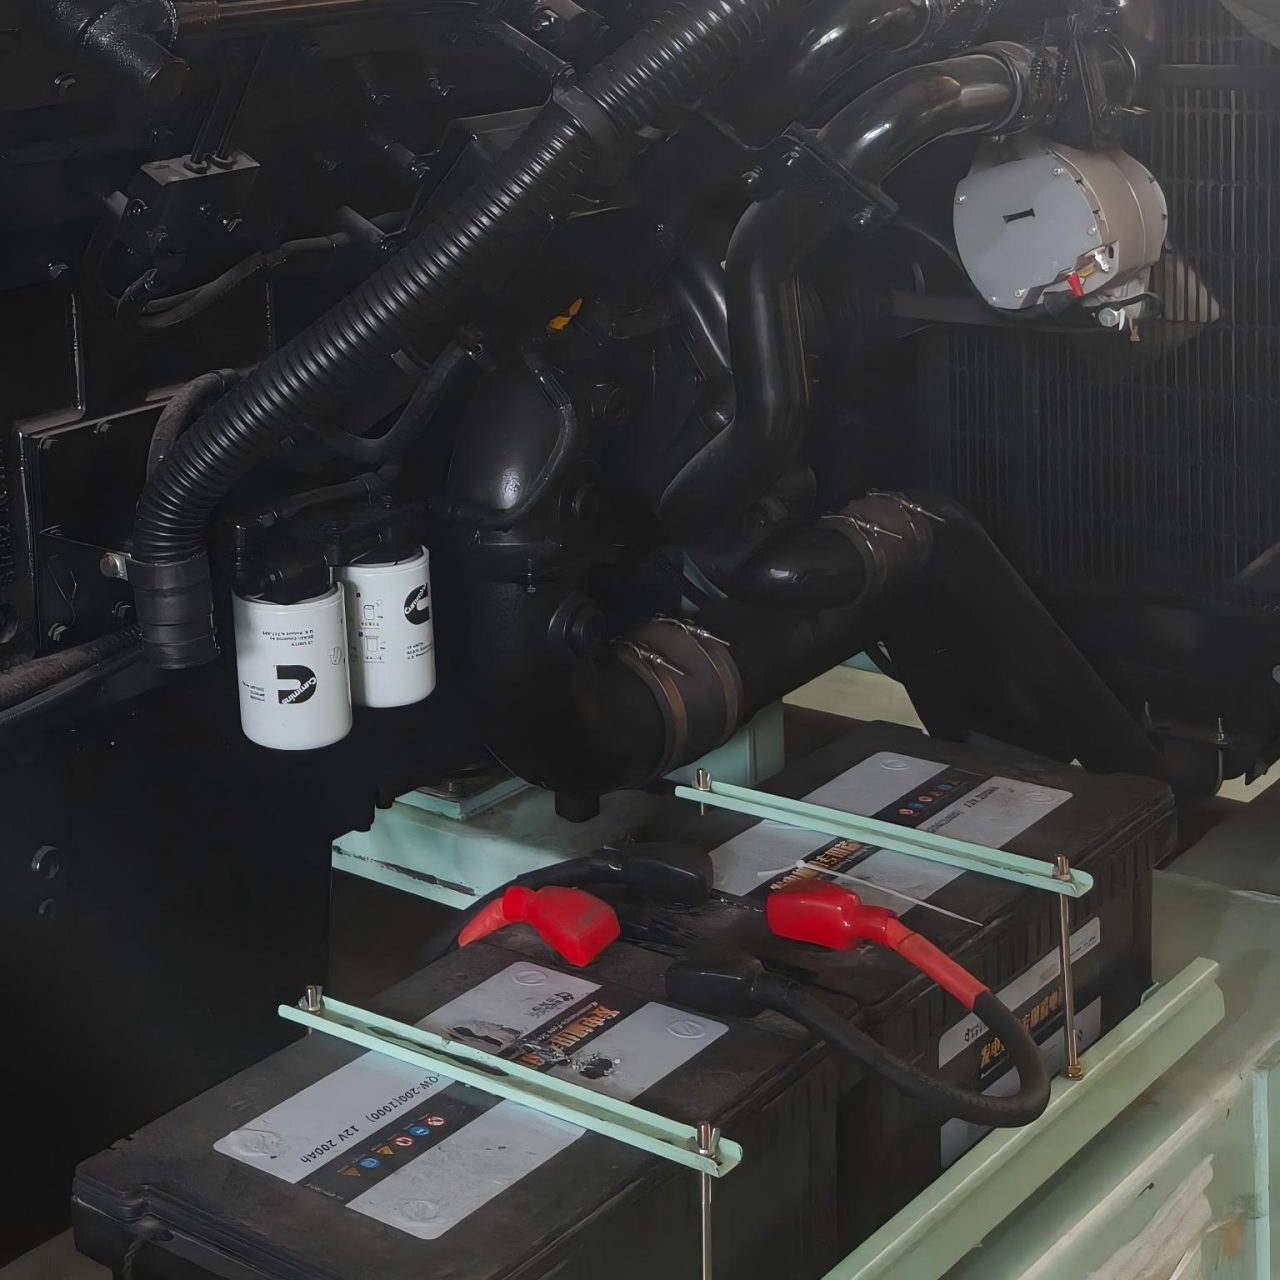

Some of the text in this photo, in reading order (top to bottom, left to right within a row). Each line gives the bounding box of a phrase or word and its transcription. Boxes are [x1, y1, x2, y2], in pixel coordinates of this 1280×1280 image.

[281, 677, 317, 704] Cummins
[300, 1073, 441, 1164] -QW-200(1000) 12V 200Ah
